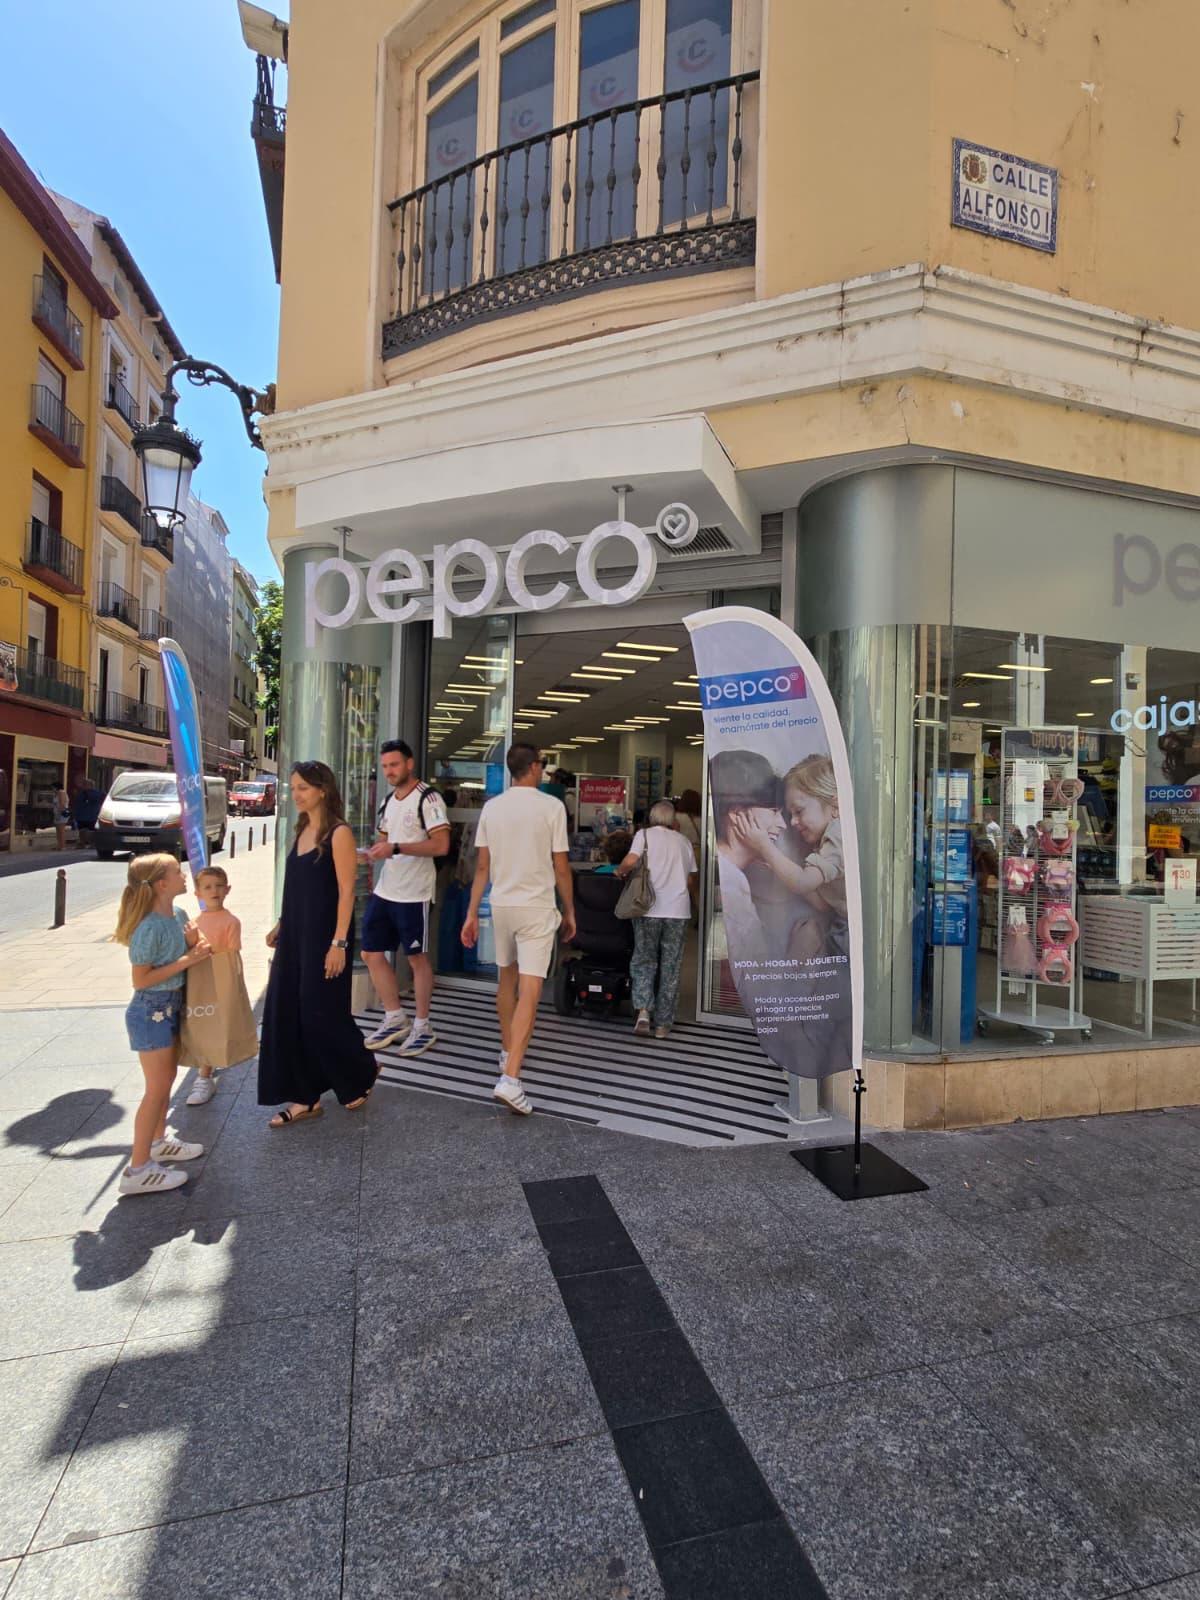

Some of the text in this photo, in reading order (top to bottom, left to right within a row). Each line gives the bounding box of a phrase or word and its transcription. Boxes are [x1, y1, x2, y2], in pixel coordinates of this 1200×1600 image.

[992, 163, 1049, 197] CALLE
[962, 187, 1041, 230] ALFONSO
[1045, 211, 1049, 233] I
[1113, 532, 1200, 607] pe
[304, 520, 657, 648] pepco
[705, 675, 791, 705] pepco
[742, 712, 751, 720] la
[1110, 695, 1200, 736] caja
[719, 716, 818, 734] enamórate del precio
[1149, 788, 1193, 801] pepco
[734, 955, 848, 969] MODA HOGAR JUGUETES
[744, 973, 751, 981] A
[752, 971, 782, 981] precios
[783, 972, 808, 981] bajos
[784, 995, 825, 1003] accesorios
[825, 993, 840, 1001] para
[763, 1006, 786, 1014] hogar
[795, 1004, 822, 1013] precios
[757, 1026, 778, 1035] bajos
